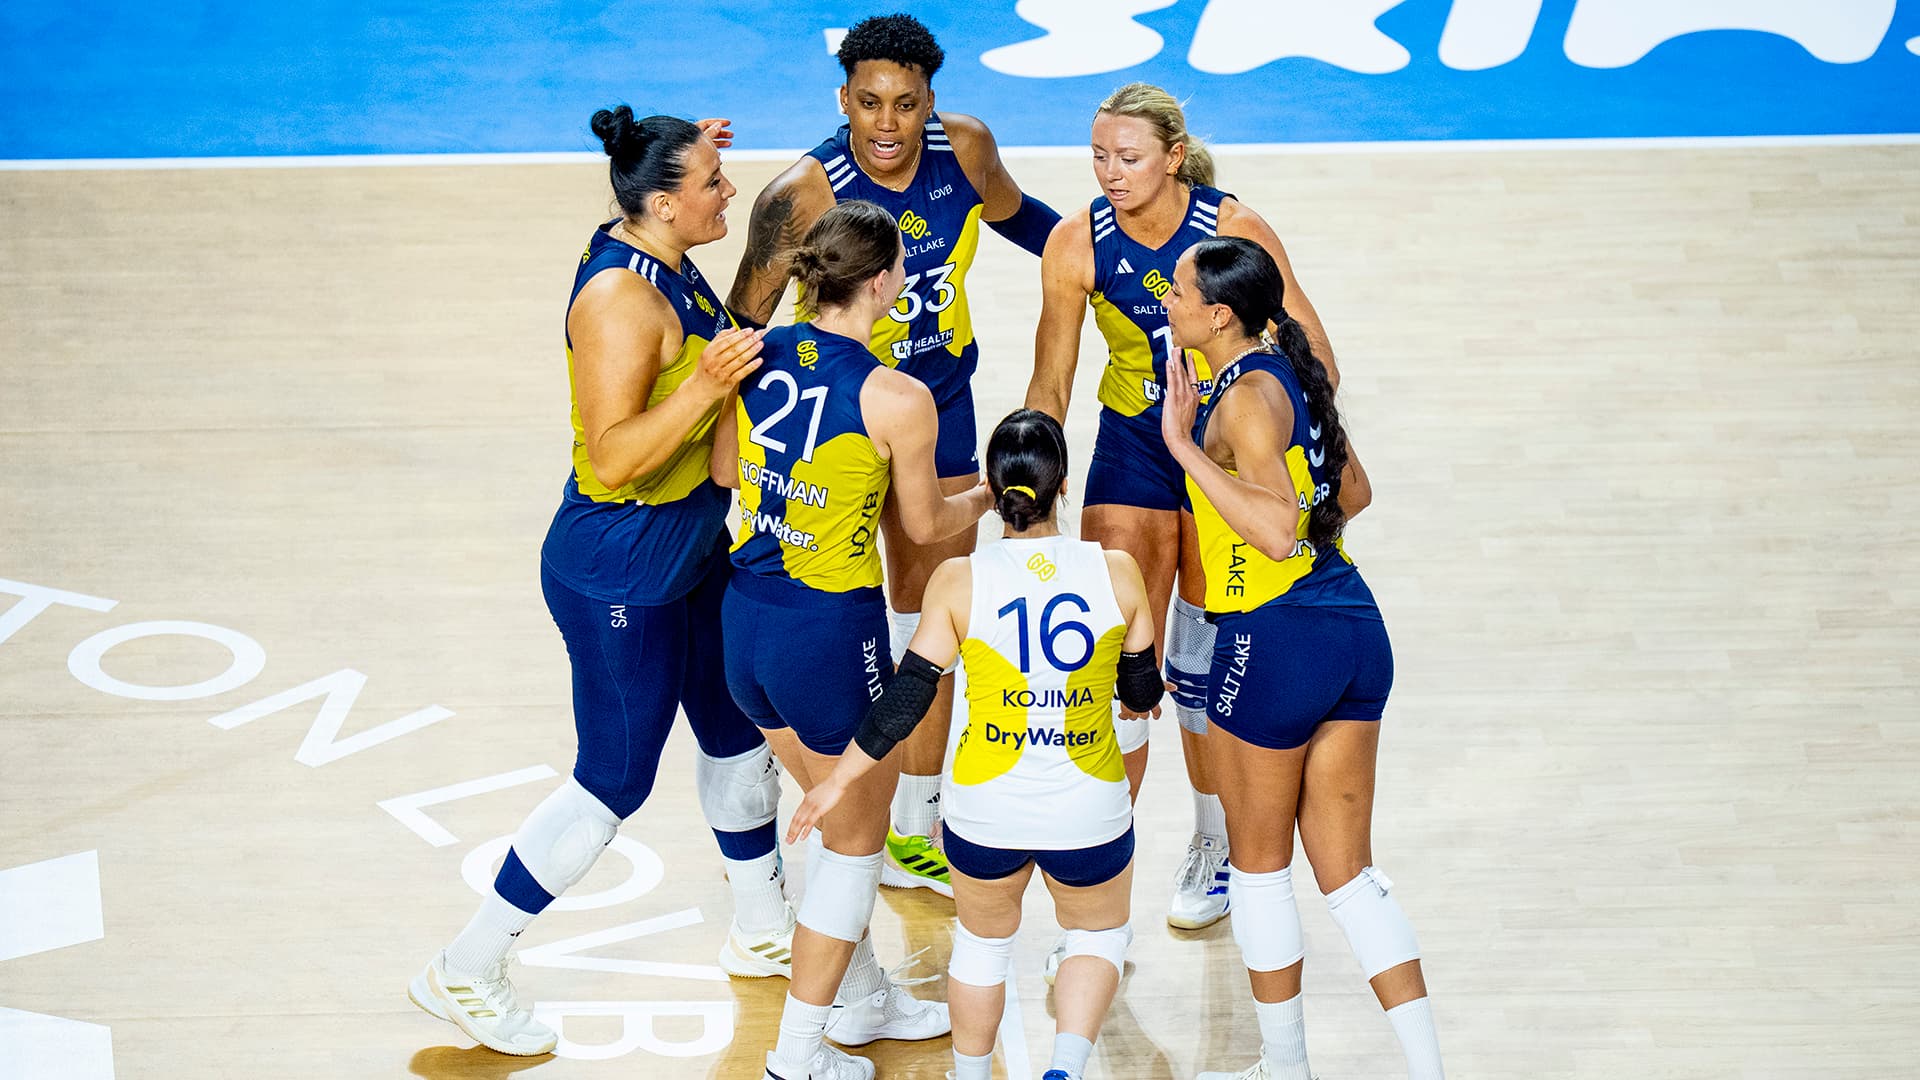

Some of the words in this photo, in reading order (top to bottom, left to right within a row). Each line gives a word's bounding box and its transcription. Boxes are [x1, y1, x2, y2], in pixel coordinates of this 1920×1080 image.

[929, 183, 953, 201] LOVB
[919, 237, 946, 254] LAKE
[889, 261, 957, 322] 33
[1133, 305, 1158, 315] SALT
[914, 329, 953, 350] HEALTH
[749, 369, 830, 464] 21
[739, 457, 828, 509] HOFFMAN
[1225, 542, 1248, 598] LAKE
[997, 592, 1095, 674] 16
[862, 637, 879, 684] LAKE
[1216, 672, 1243, 717] SALT
[1233, 632, 1252, 677] LAKE
[1002, 687, 1094, 708] KOJIMA
[376, 763, 738, 1062] LOVB
